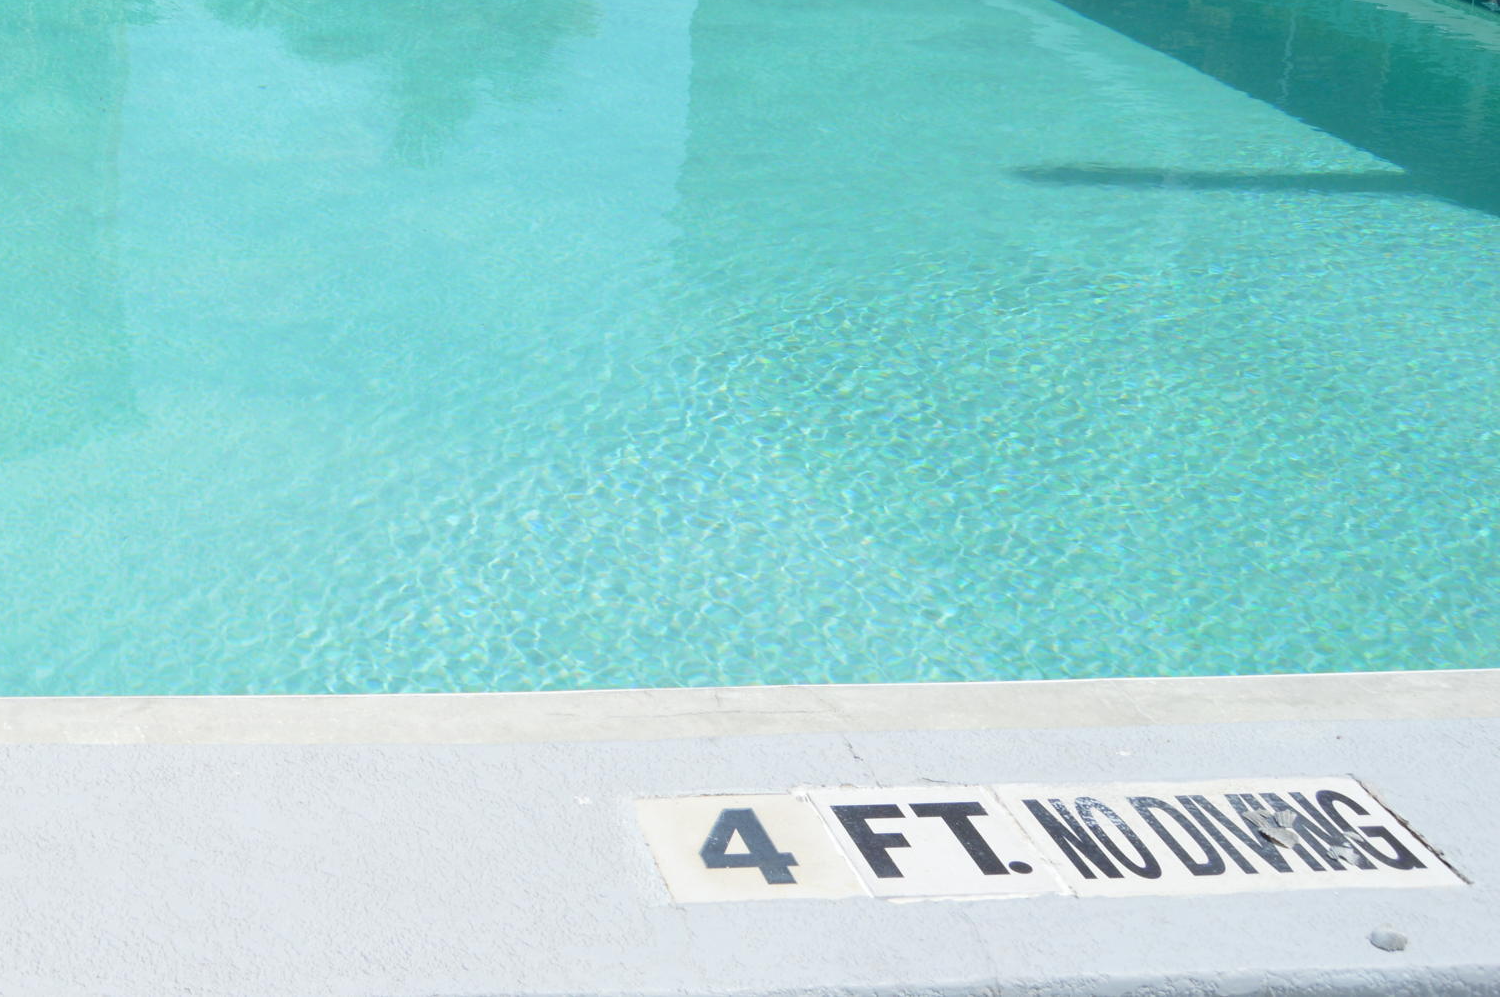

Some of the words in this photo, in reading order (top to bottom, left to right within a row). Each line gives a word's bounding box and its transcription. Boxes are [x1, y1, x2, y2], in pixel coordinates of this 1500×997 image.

[699, 808, 799, 884] 4
[830, 801, 1033, 878] FT.
[1021, 796, 1162, 879] NO
[1127, 789, 1428, 876] DIVING
